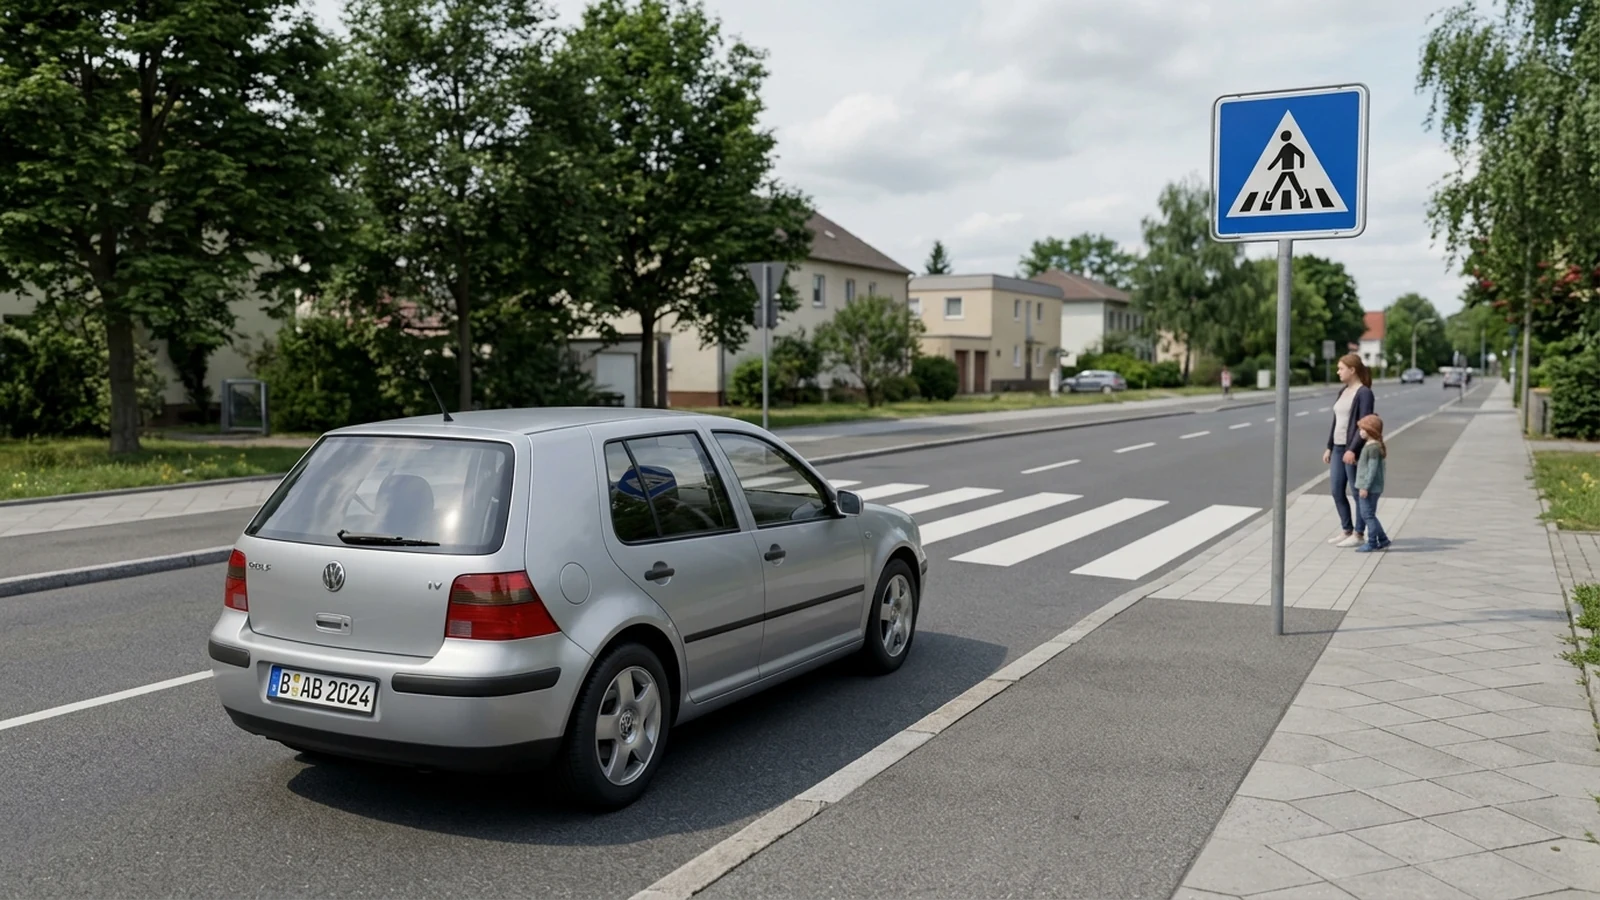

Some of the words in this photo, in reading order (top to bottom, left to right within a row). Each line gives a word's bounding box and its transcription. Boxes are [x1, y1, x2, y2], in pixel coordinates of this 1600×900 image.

[280, 672, 291, 694] B
[300, 676, 323, 699] AB
[325, 680, 370, 707] 2024
